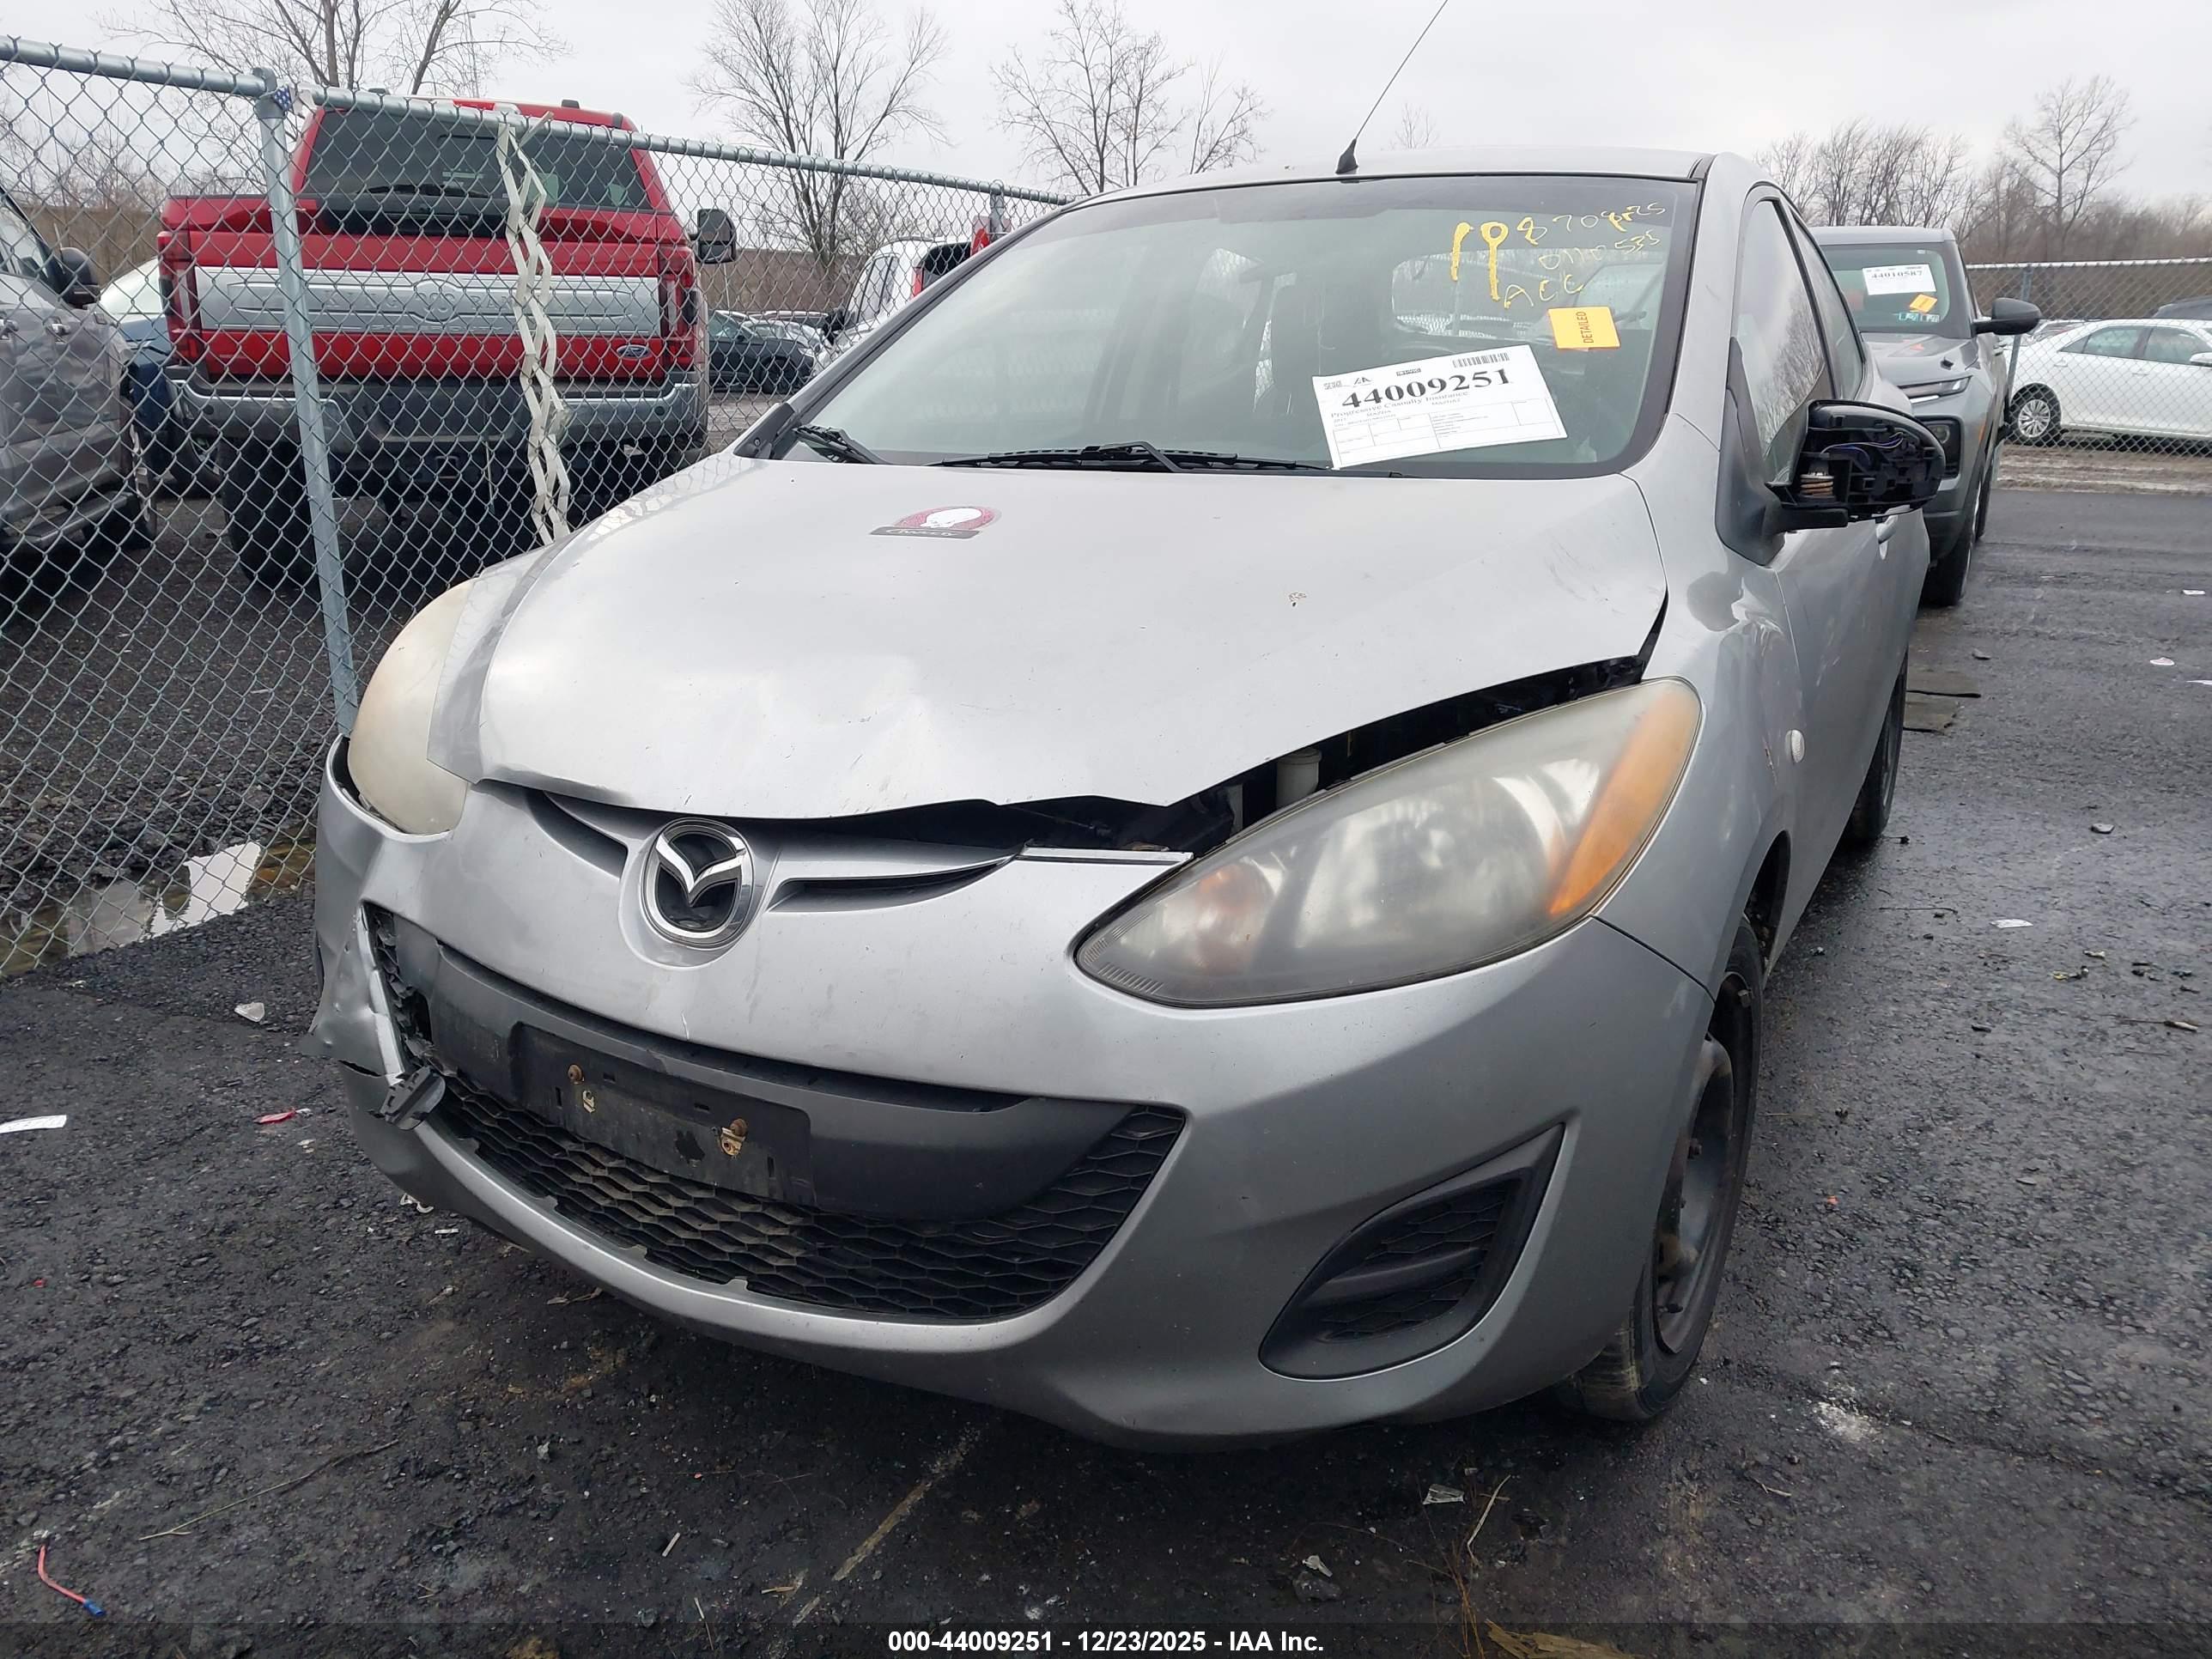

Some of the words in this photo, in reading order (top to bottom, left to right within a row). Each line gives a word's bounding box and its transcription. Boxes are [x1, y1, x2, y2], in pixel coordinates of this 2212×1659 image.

[1575, 311, 1595, 343] DETAILED
[1341, 368, 1510, 408] 44009251
[1331, 404, 1382, 417] Progressive
